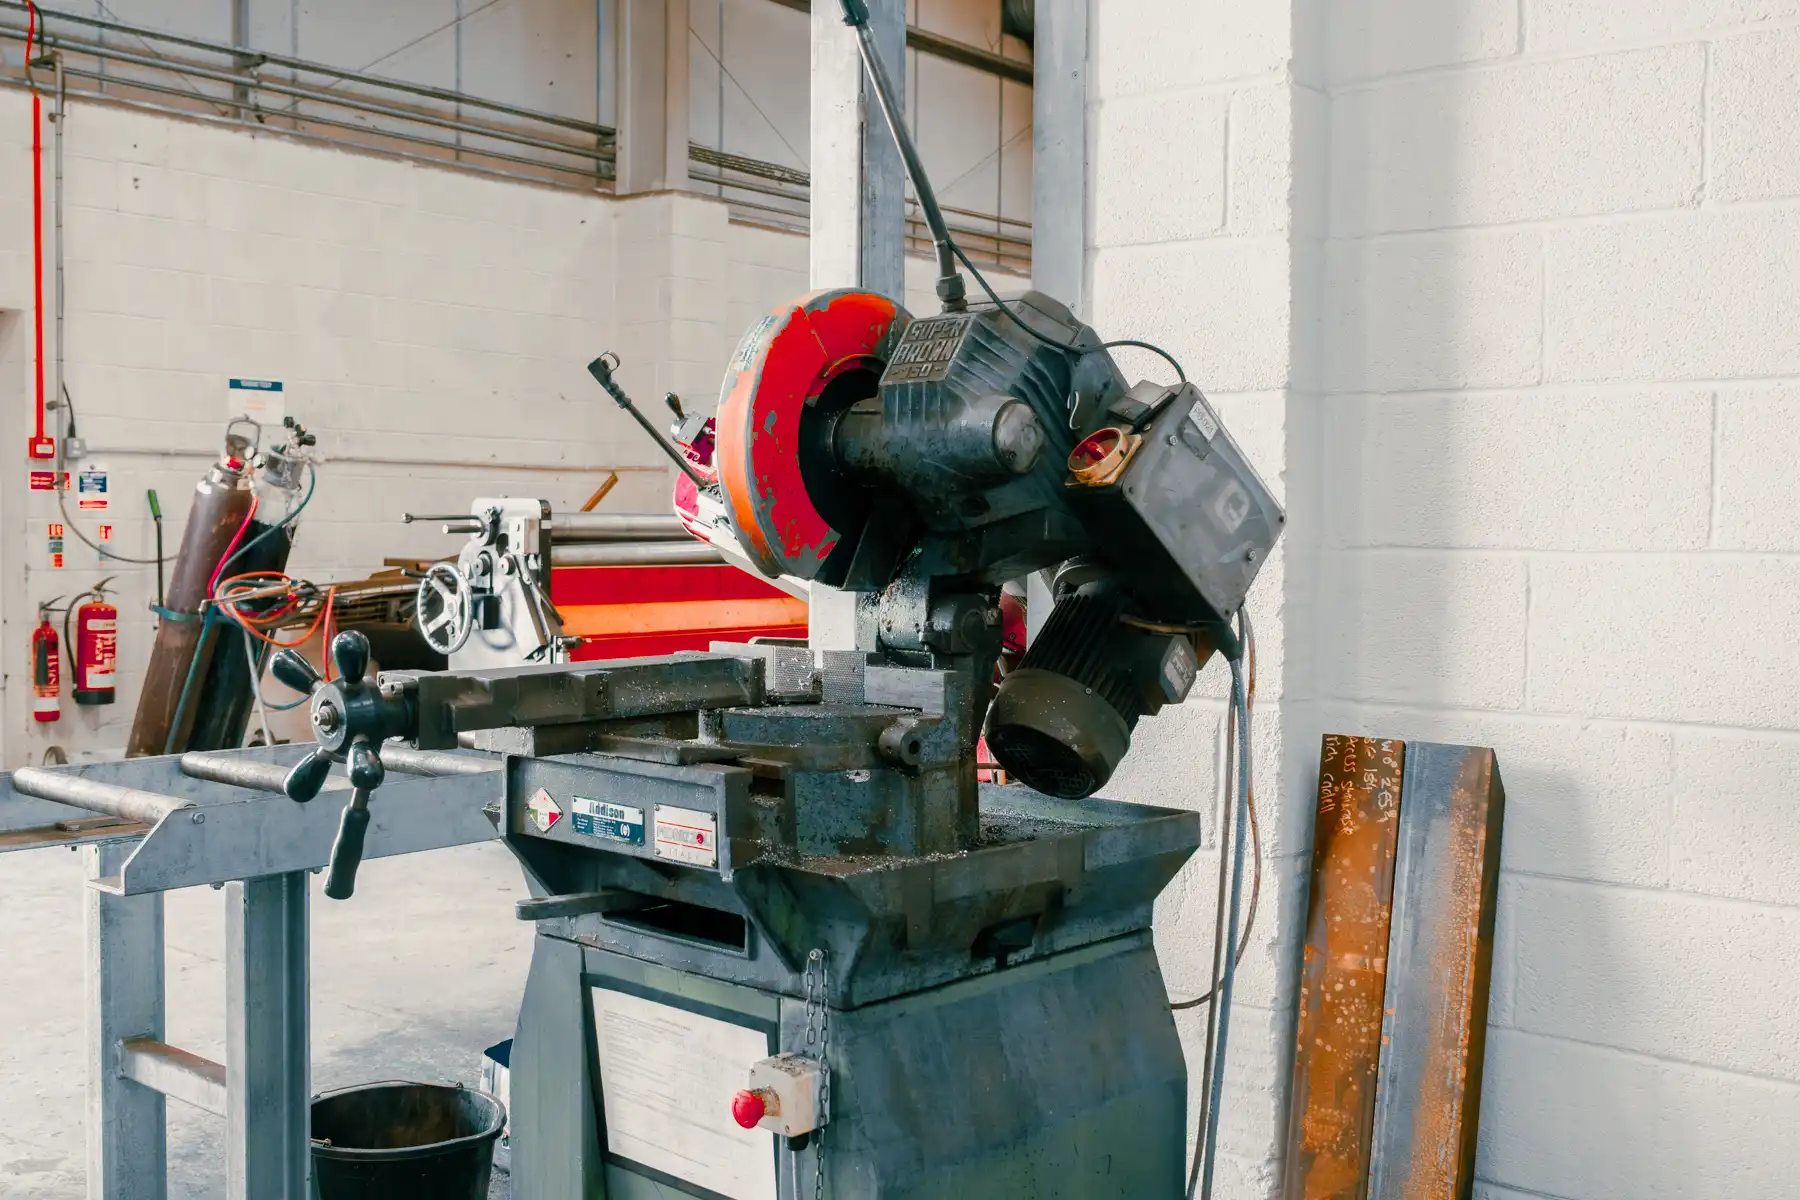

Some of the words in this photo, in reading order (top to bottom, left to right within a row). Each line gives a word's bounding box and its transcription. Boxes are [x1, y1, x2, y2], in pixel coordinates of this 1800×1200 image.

[907, 319, 966, 340] SUPER
[893, 339, 960, 364] BROWN
[589, 801, 625, 820] Addison
